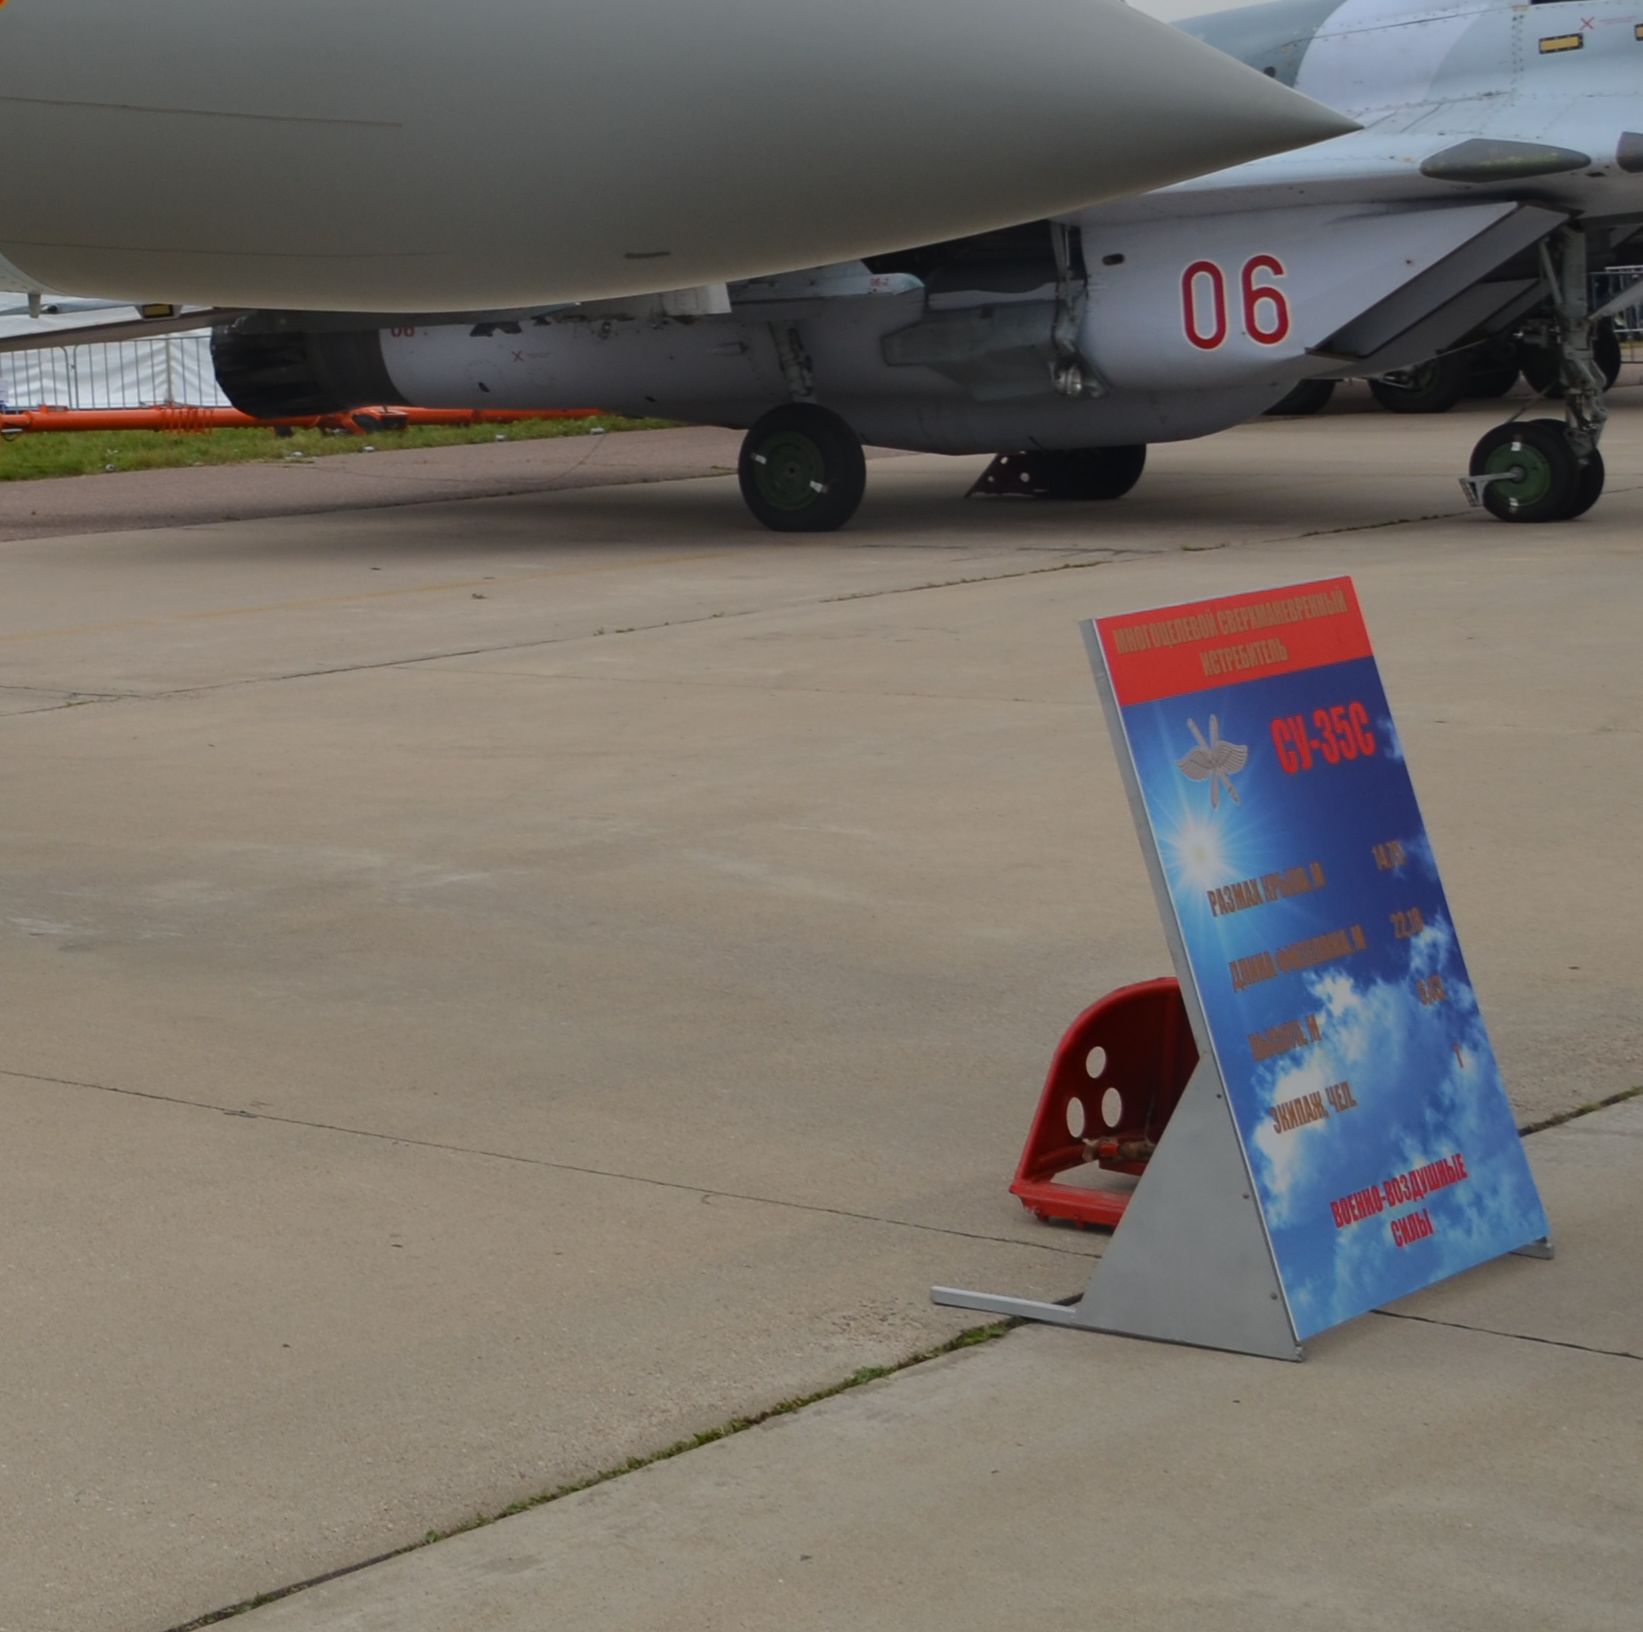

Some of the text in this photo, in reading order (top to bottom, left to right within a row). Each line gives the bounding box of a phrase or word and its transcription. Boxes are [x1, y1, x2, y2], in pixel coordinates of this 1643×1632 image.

[1180, 253, 1291, 351] 06
[1112, 588, 1350, 655] МНОГОЦЕЛЕВОЙ СВЕРХМАНЕВРЕННЫЙ
[1200, 637, 1289, 676] ИСТРЕБИТЕЛЬ
[1270, 701, 1376, 774] СУ-35С
[1207, 878, 1264, 917] РАЗМАХ
[1269, 1042, 1465, 1135] ЭКИПАЖ, ЧЕЛ. 1
[1329, 1152, 1469, 1229] ВОЕННО-ВОЗДУШНЫЕ
[1390, 1207, 1435, 1249] СИЛЫ
